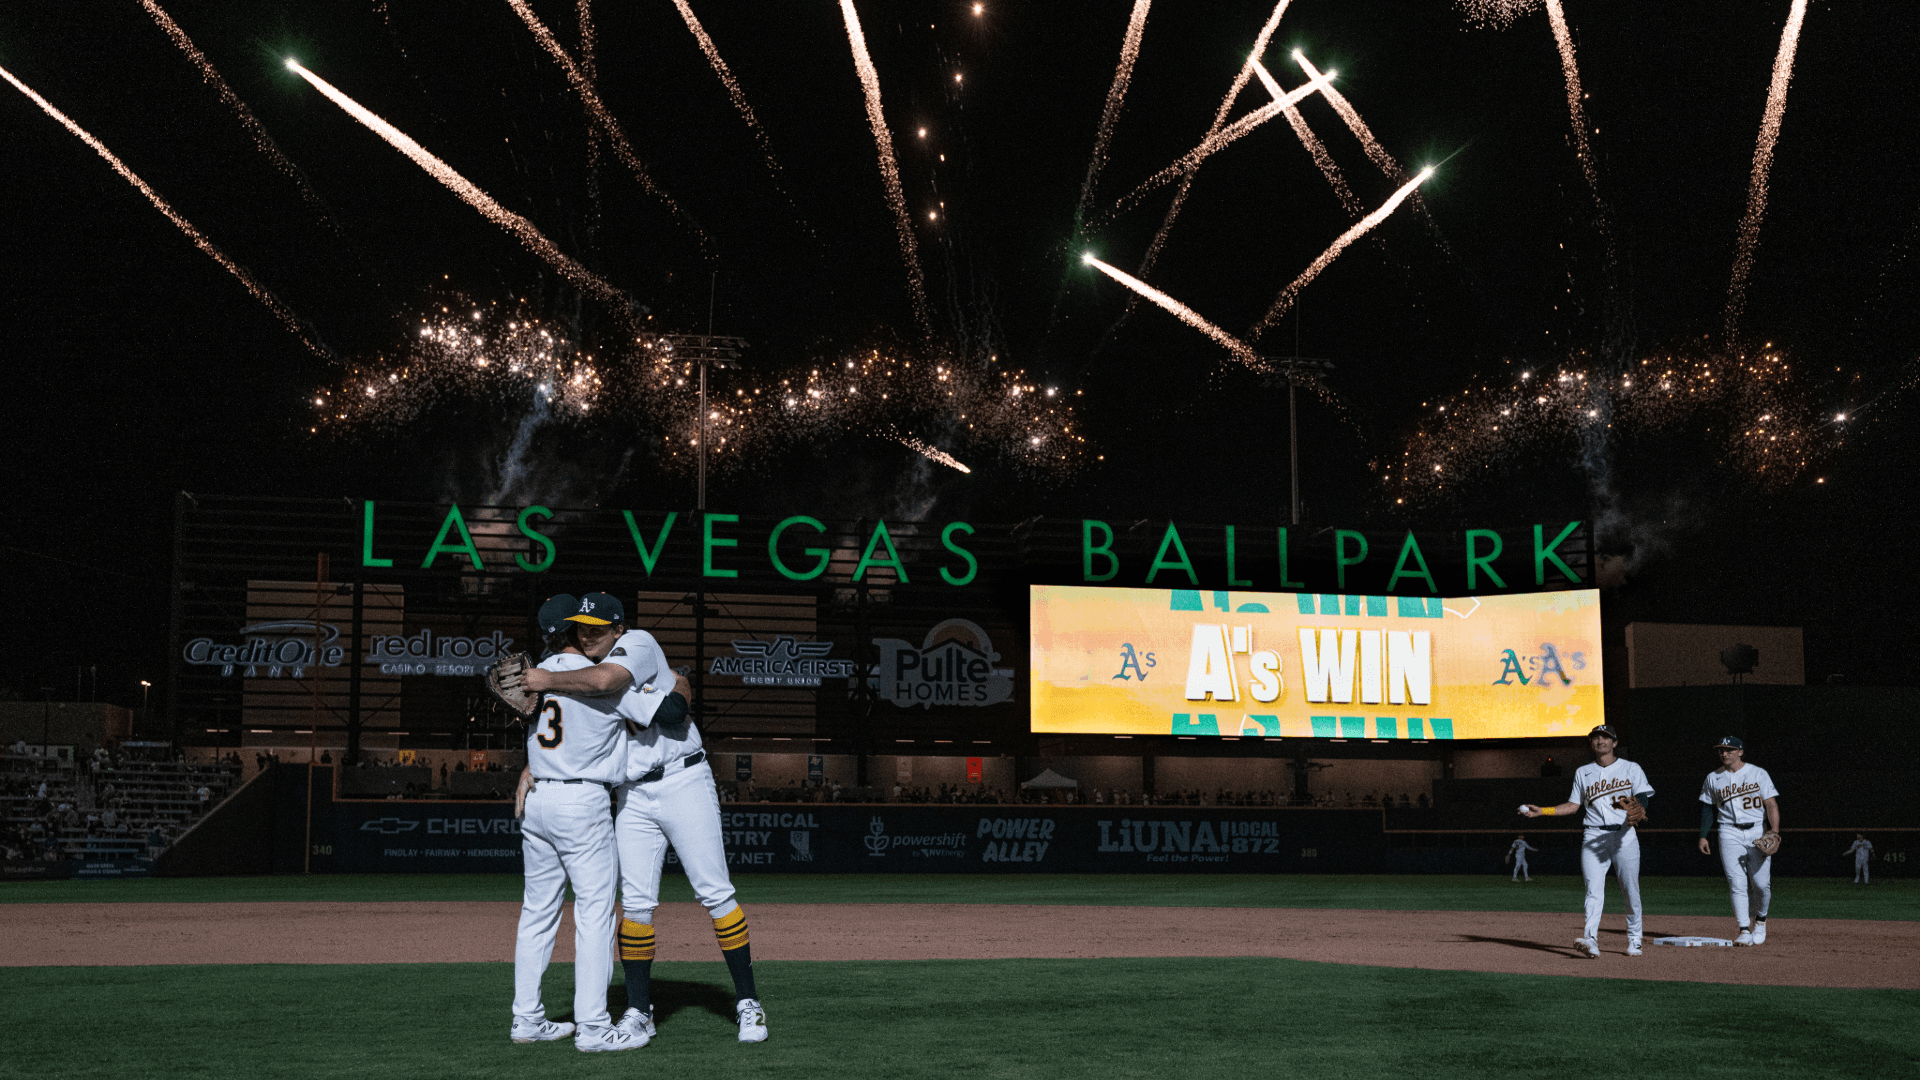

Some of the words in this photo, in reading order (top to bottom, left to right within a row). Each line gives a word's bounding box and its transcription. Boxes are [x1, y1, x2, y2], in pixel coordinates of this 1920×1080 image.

[363, 500, 556, 573] LAS
[622, 509, 978, 586] VEGAS
[1082, 519, 1583, 593] BALLPARK
[579, 598, 595, 613] A's
[371, 628, 431, 657] red
[436, 630, 514, 658] rock
[381, 663, 426, 675] CASINO
[711, 659, 795, 674] AMERICA
[799, 660, 853, 675] FIRST
[896, 647, 990, 683] Pulte
[1112, 643, 1157, 682] A's
[1185, 623, 1283, 703] A's
[1297, 626, 1431, 706] WIN
[222, 665, 305, 677] BANK
[787, 677, 821, 685] UNION
[896, 682, 988, 701] HOMES
[537, 698, 563, 750] 3
[1742, 796, 1763, 810] 20
[721, 813, 820, 828] ECTRICAL
[976, 818, 1056, 840] POWER
[1097, 818, 1231, 853] LiUNA!
[1231, 821, 1280, 837] LOCAL
[722, 831, 772, 846] STRY
[892, 832, 968, 848] powershift
[1231, 837, 1280, 853] 872
[312, 845, 332, 855] 340
[384, 849, 418, 857] FINDLAY
[425, 849, 460, 857] FAIRWAY
[467, 849, 516, 857] HENDERSON
[982, 840, 1050, 862] ALLEY
[1147, 854, 1171, 862] Feel
[1172, 854, 1189, 862] the
[1191, 854, 1229, 862] Power!
